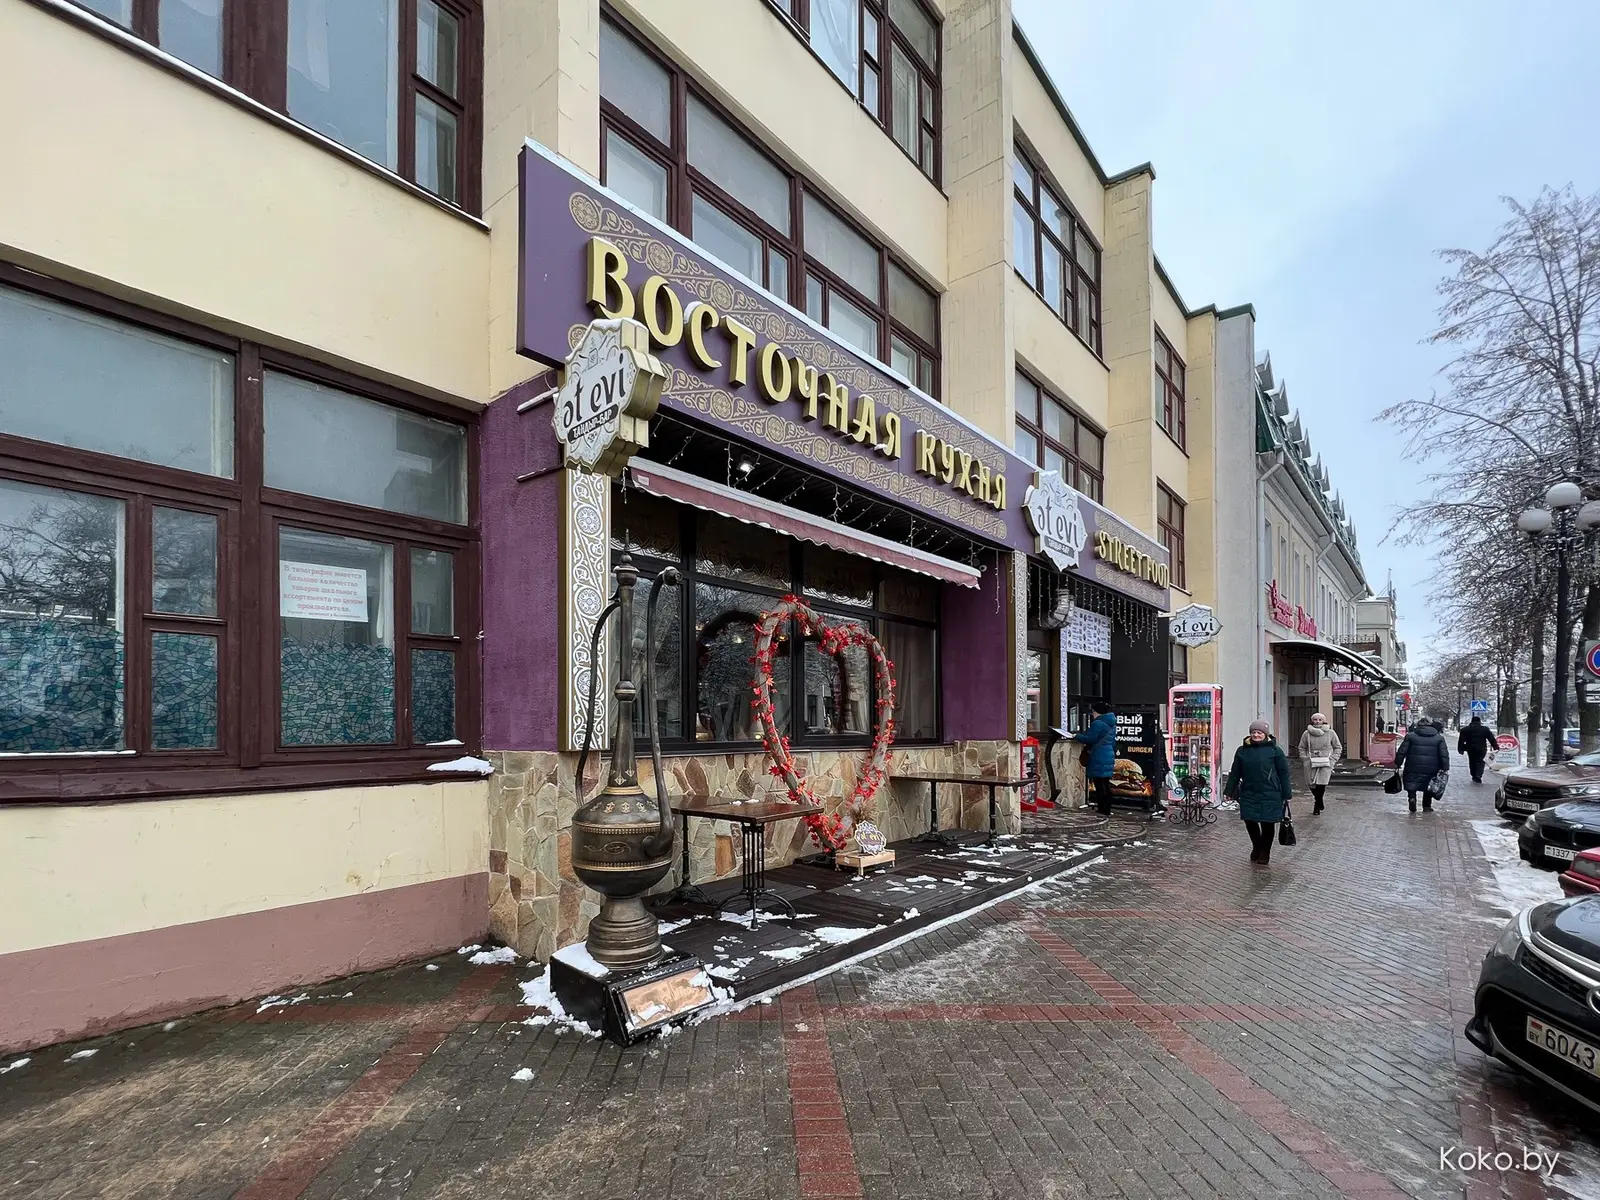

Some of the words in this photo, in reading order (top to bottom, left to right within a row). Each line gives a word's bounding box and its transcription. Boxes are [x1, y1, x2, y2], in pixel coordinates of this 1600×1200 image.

[586, 236, 902, 460] ВОСТОЧНАЯ
[916, 430, 1007, 510] КУХНЯ
[590, 353, 627, 412] evi
[1056, 512, 1079, 548] evi
[1095, 530, 1142, 578] STREET
[1143, 554, 1170, 589] FOOD
[1192, 618, 1214, 632] evi
[1115, 726, 1143, 735] РГЕР
[1116, 713, 1143, 725] ВЫЙ
[1552, 848, 1570, 858] 1337
[1546, 1029, 1595, 1069] 6043
